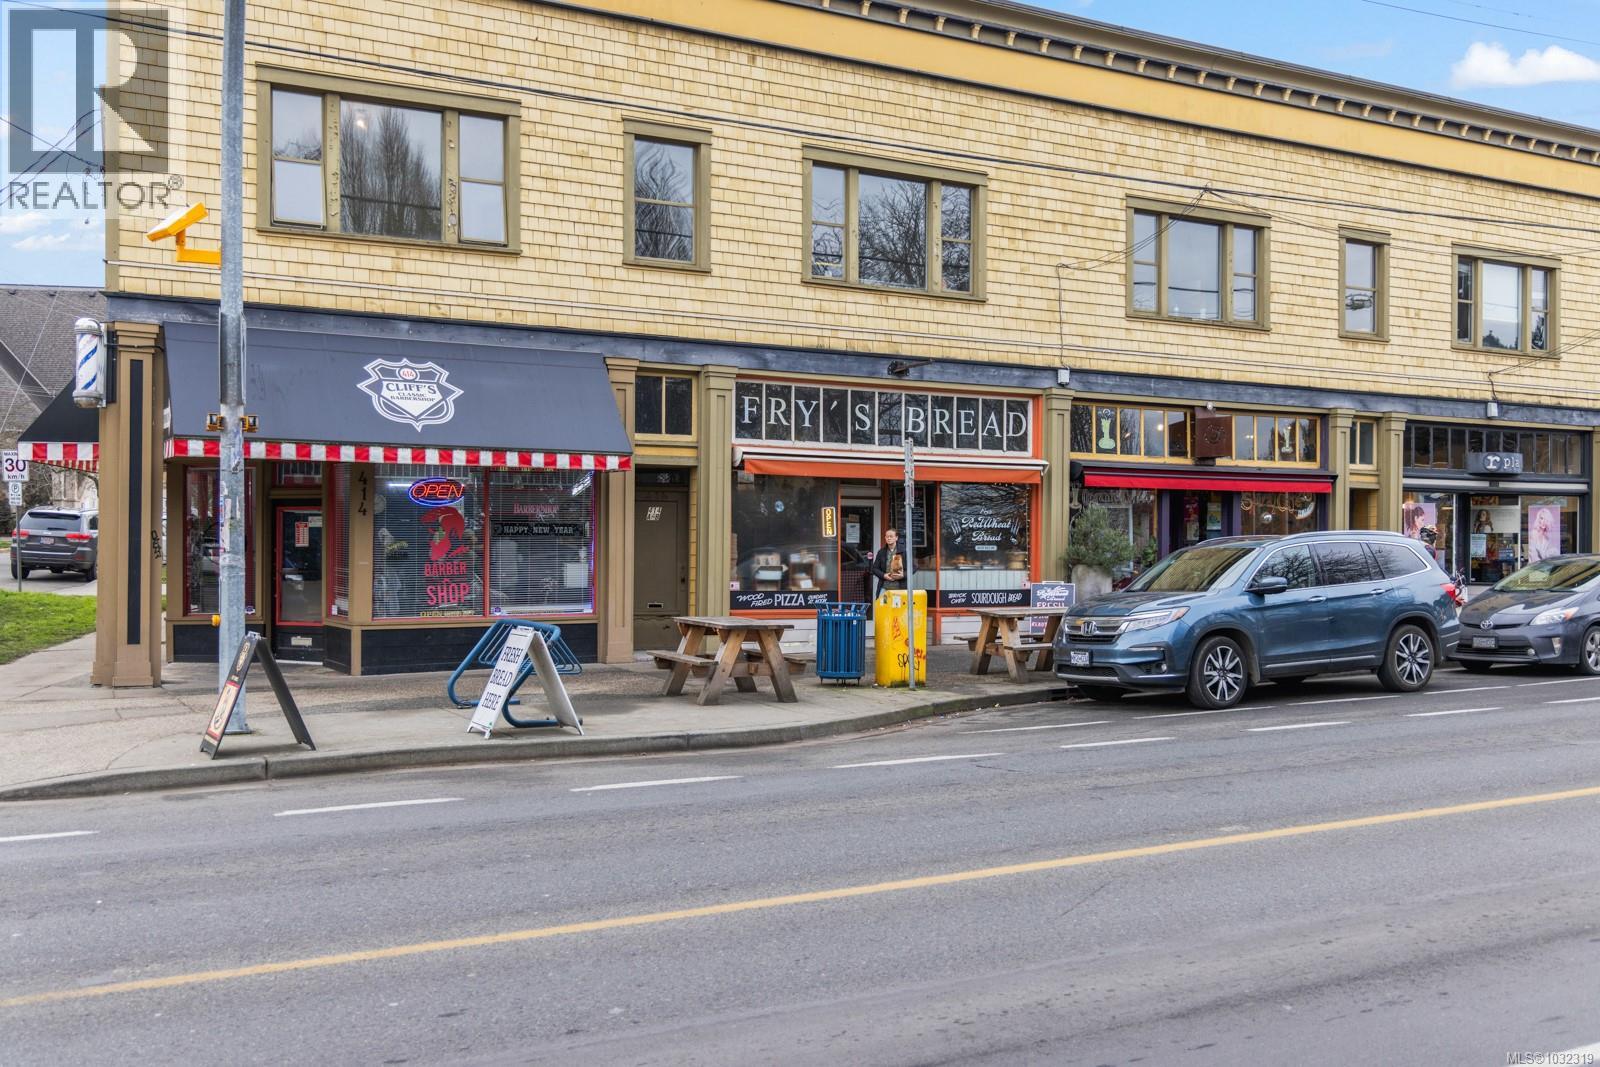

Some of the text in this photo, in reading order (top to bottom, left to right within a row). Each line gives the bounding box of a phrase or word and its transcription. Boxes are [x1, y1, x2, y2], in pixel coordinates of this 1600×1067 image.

[385, 382, 437, 395] CLIFF'S
[906, 406, 1027, 438] BREAD
[4, 457, 27, 472] 30
[412, 484, 463, 498] OPEN
[824, 508, 834, 536] OPEN
[503, 525, 574, 535] HAPPY NEW YEAR
[424, 561, 467, 577] BARBER
[426, 582, 470, 606] SHOP
[736, 592, 765, 602] WOOD
[773, 593, 806, 607] PIZZA
[970, 592, 1023, 604] SOURDOUGH BREAD
[750, 598, 773, 608] FIRED
[501, 646, 524, 664] FRESH
[490, 668, 513, 688] BREAD
[482, 691, 501, 711] HERE
